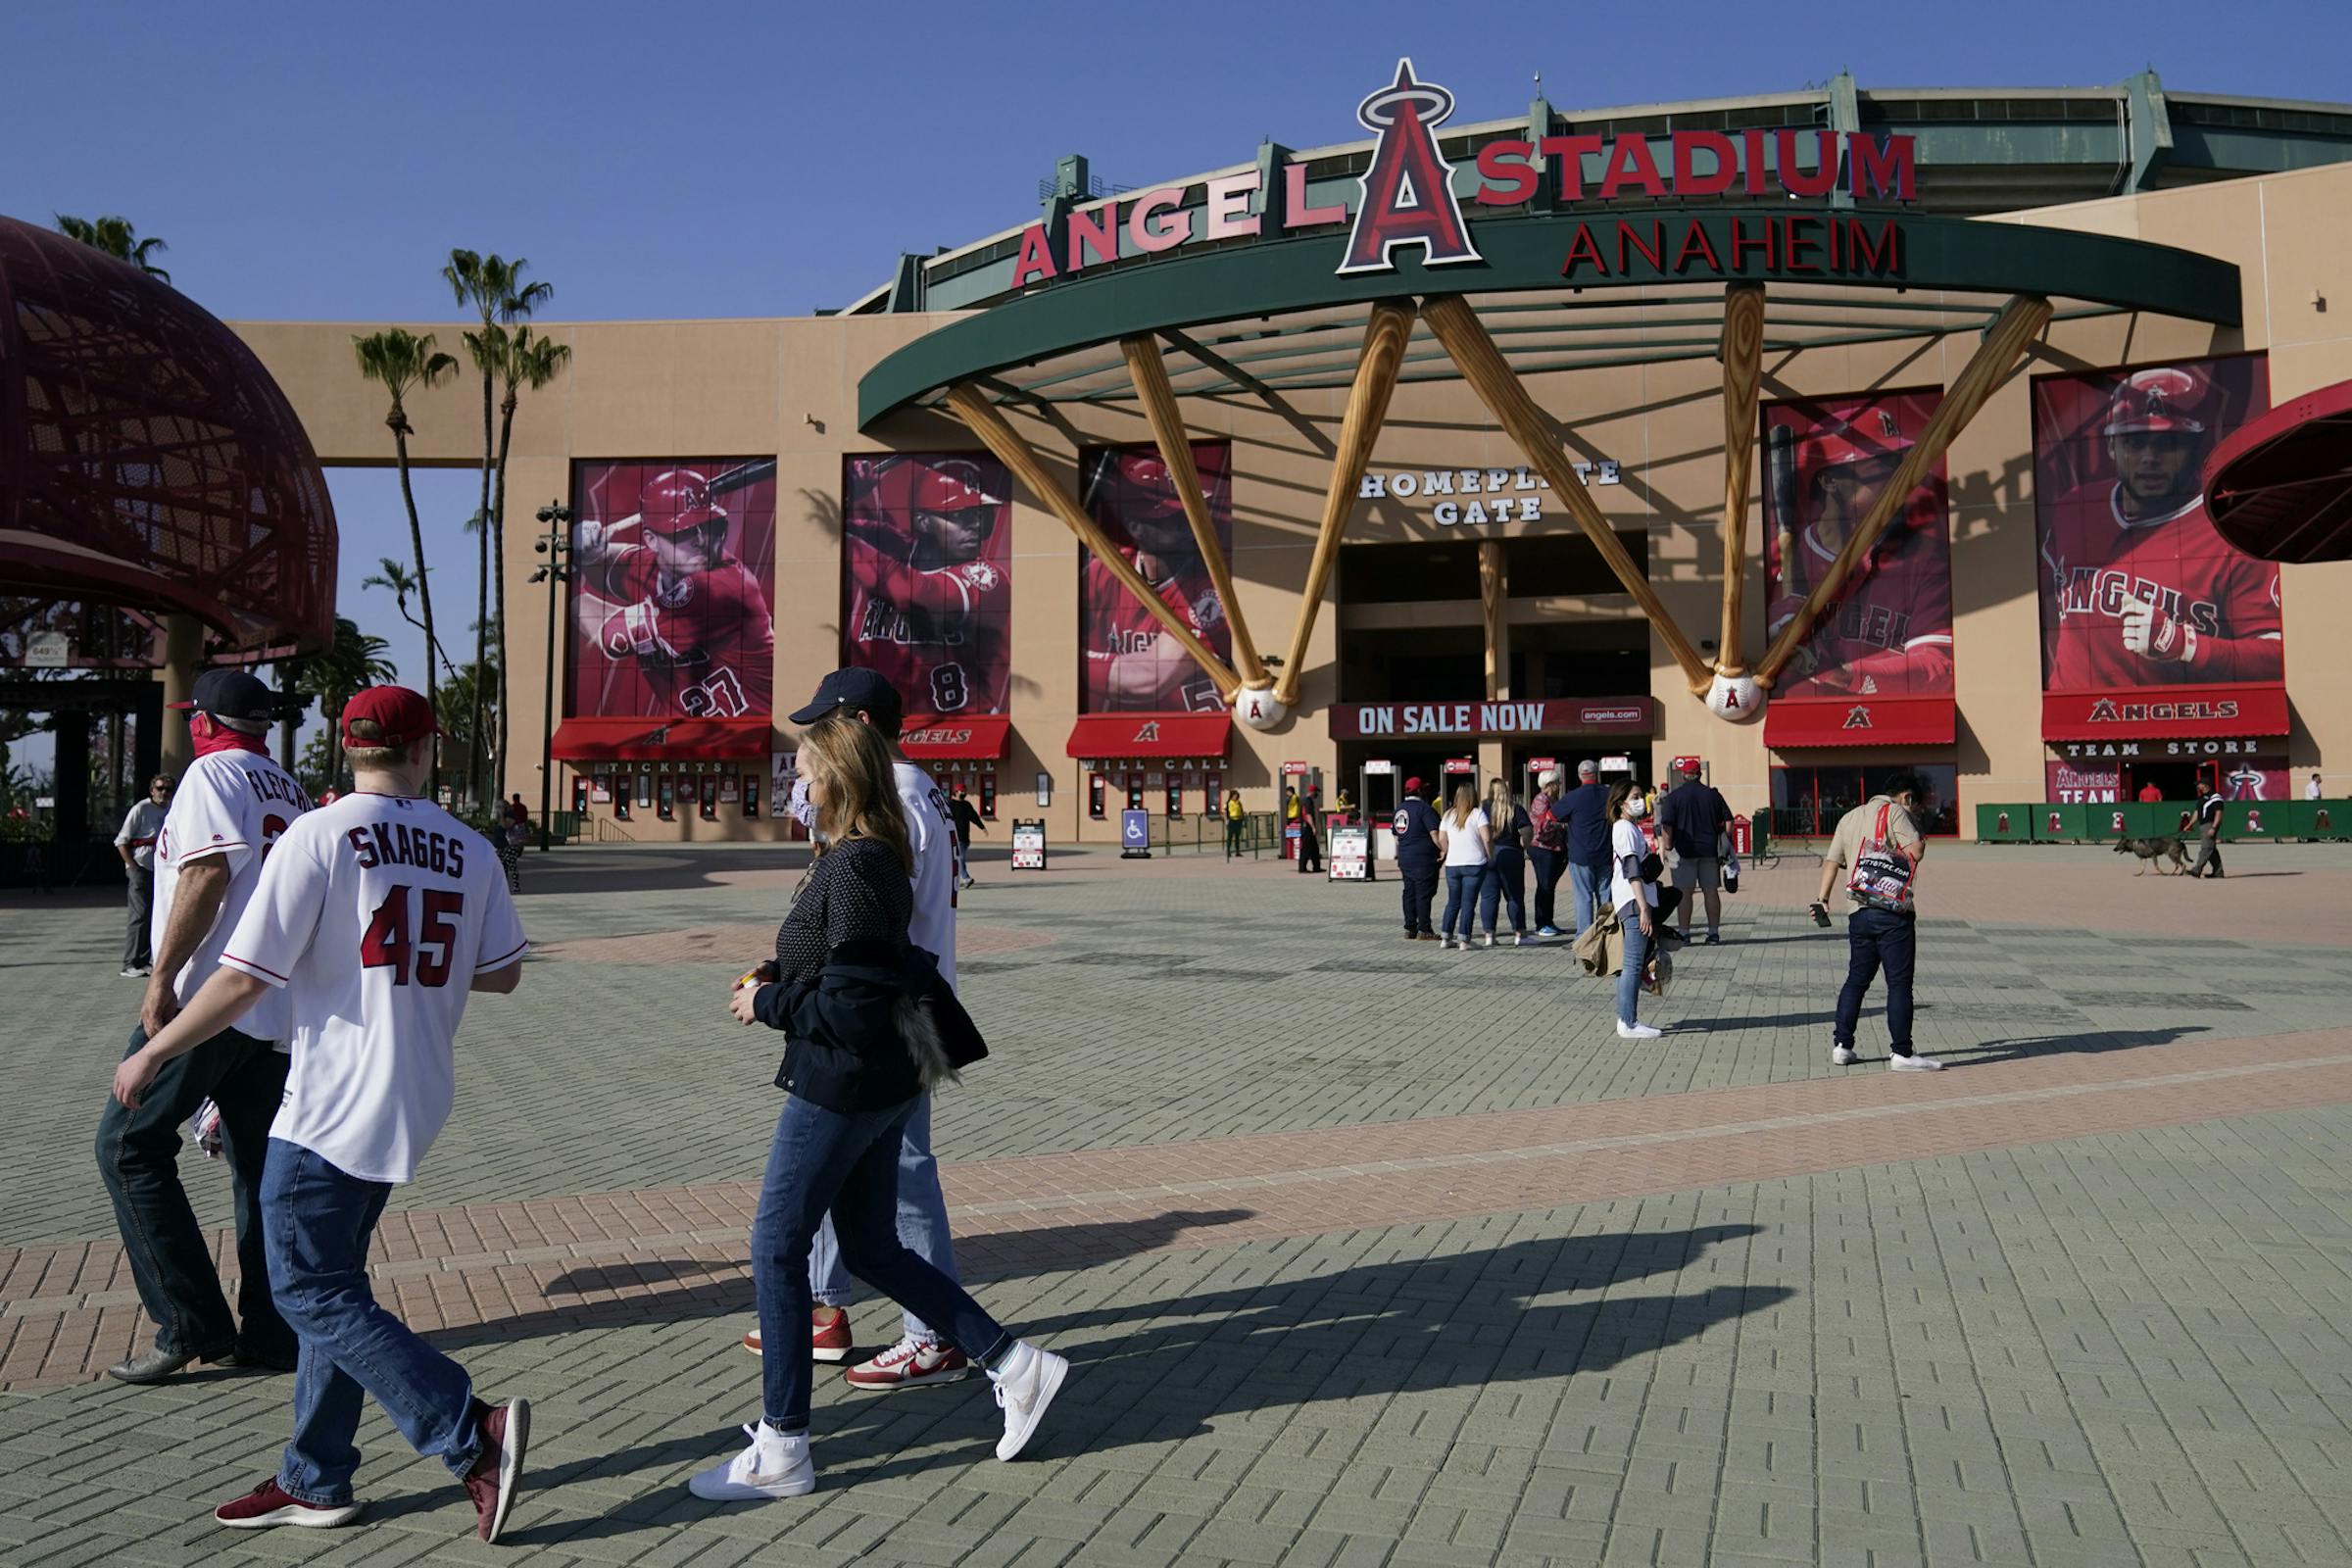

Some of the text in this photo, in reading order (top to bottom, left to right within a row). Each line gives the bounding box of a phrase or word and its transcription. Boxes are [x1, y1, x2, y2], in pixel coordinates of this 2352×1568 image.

[1010, 56, 1916, 289] ANGEL A STADIUM
[1560, 215, 1899, 276] ANAHEIM
[1358, 461, 1620, 499] HOMEPLTE
[1433, 496, 1542, 526] GATE
[679, 665, 749, 717] 27
[930, 662, 968, 711] 8
[1726, 686, 1740, 710] A
[1250, 698, 1262, 719] A
[1358, 704, 1544, 734] ON SALE NOW
[1584, 710, 1639, 721] angels.com
[1842, 705, 1873, 729] A
[2087, 698, 2239, 723] ANGELS
[1133, 720, 1160, 743] A
[2068, 740, 2258, 757] TEAM STORE
[610, 761, 722, 773] TICKETS
[933, 760, 995, 772] CALL
[1081, 759, 1228, 771] WILL CALL
[245, 769, 315, 813] FLETCH
[2059, 789, 2115, 804] TEAM
[348, 821, 465, 879] SKAGGS
[361, 884, 465, 988] 45
